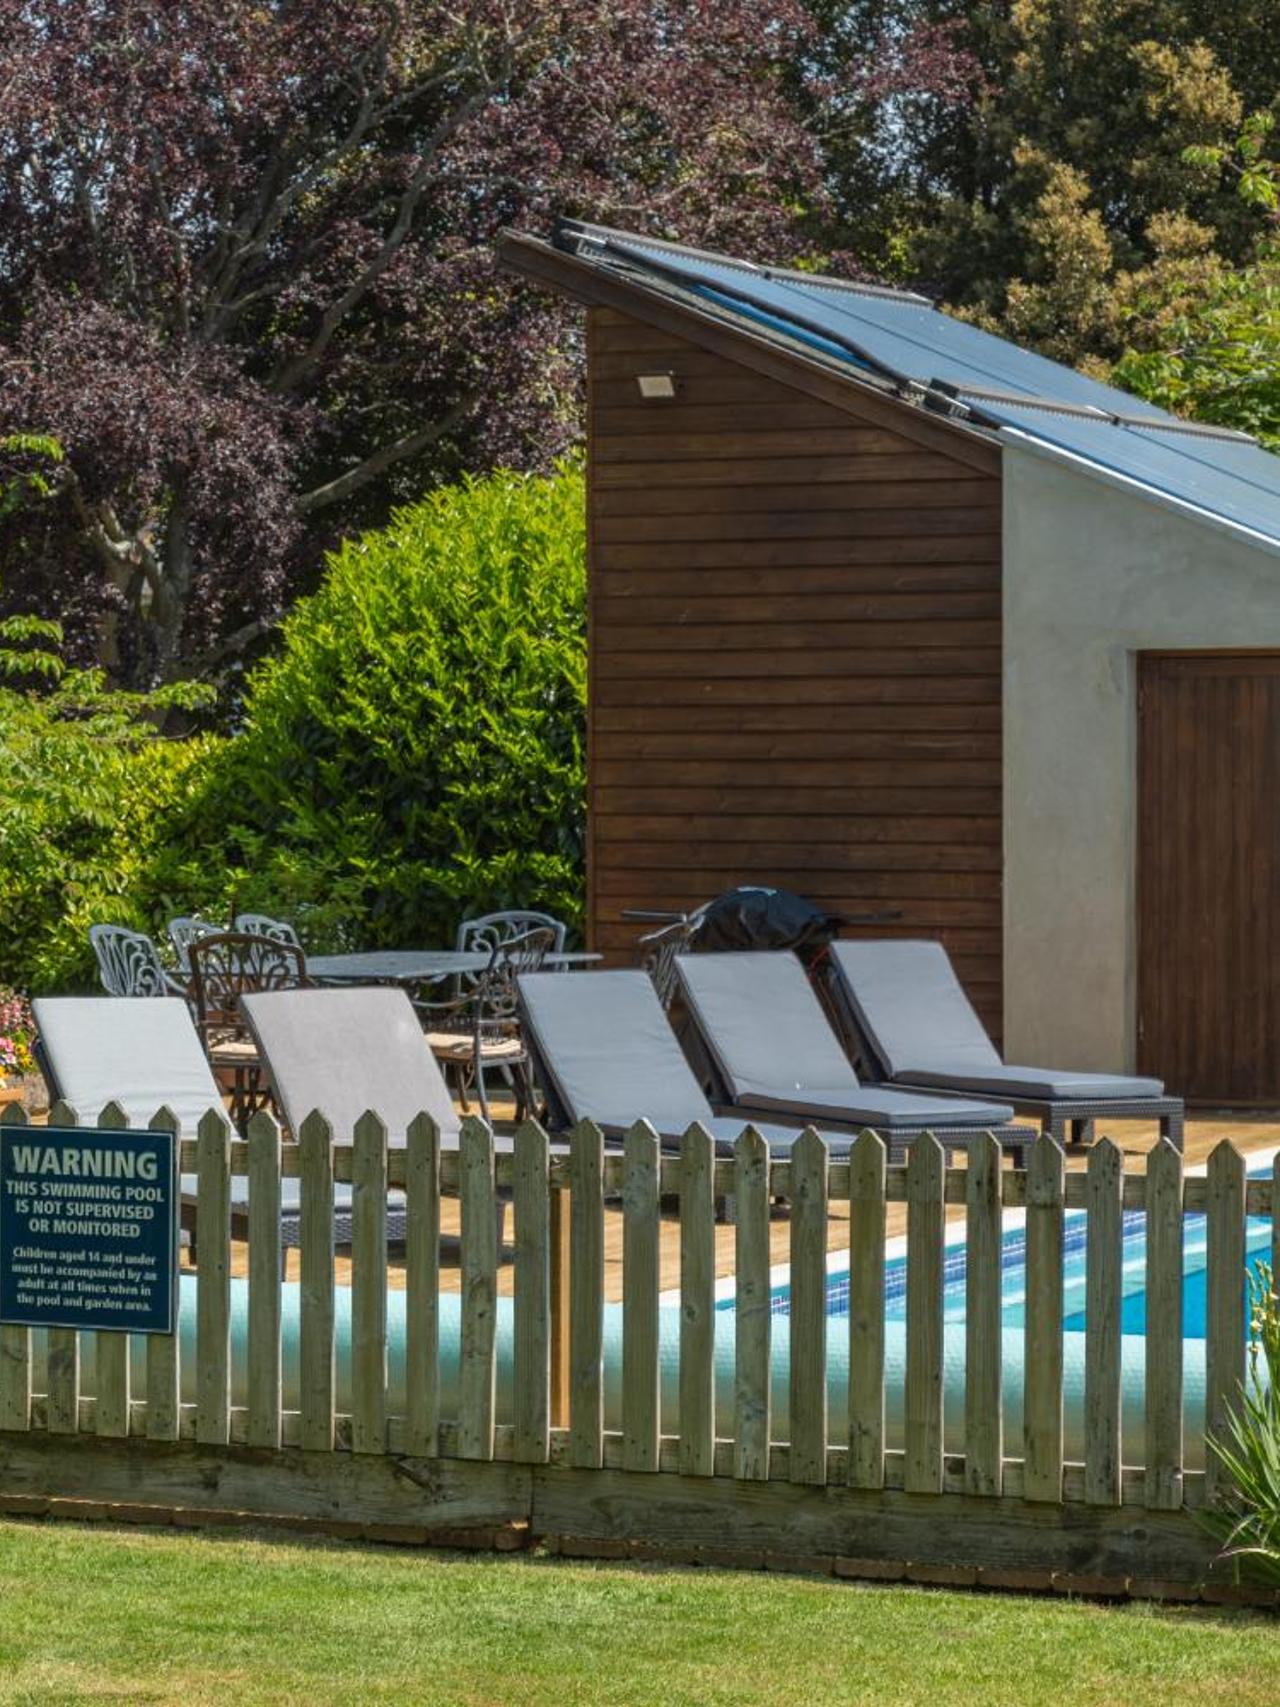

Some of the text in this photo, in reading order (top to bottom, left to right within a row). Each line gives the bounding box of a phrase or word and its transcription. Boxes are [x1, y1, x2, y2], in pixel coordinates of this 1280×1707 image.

[12, 1146, 158, 1180] WARNING
[5, 1180, 165, 1202] THIS SWIMMING POOL
[16, 1199, 154, 1219] IS NOT SUPERVISED
[29, 1218, 140, 1237] OR MONITORED
[13, 1247, 156, 1265] Children aged 14 and under
[12, 1263, 157, 1282] must be accompanied by an
[17, 1278, 151, 1296] adult at all times when in
[17, 1294, 151, 1311] the pool and garden area.
